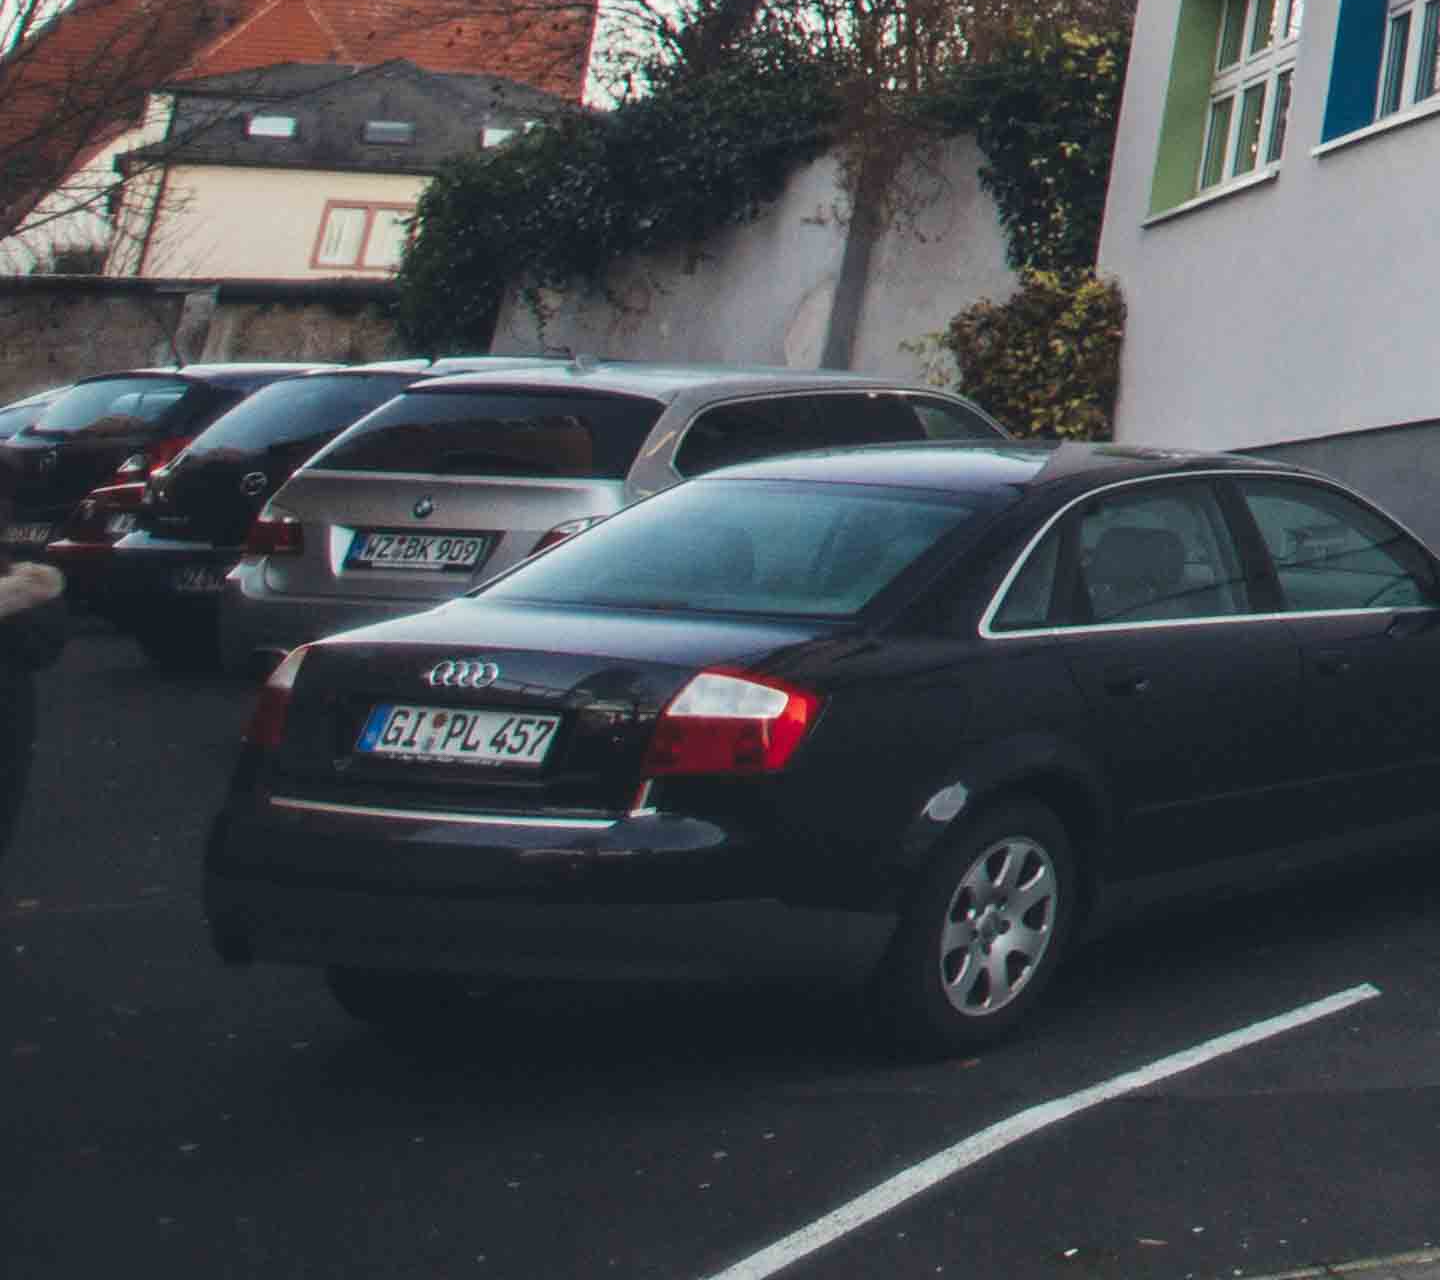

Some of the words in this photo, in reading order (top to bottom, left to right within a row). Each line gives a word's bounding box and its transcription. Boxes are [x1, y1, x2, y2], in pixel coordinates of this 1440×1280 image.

[436, 539, 479, 561] 909
[381, 709, 427, 748] GI
[440, 713, 481, 752] PL
[488, 717, 556, 757] 457
